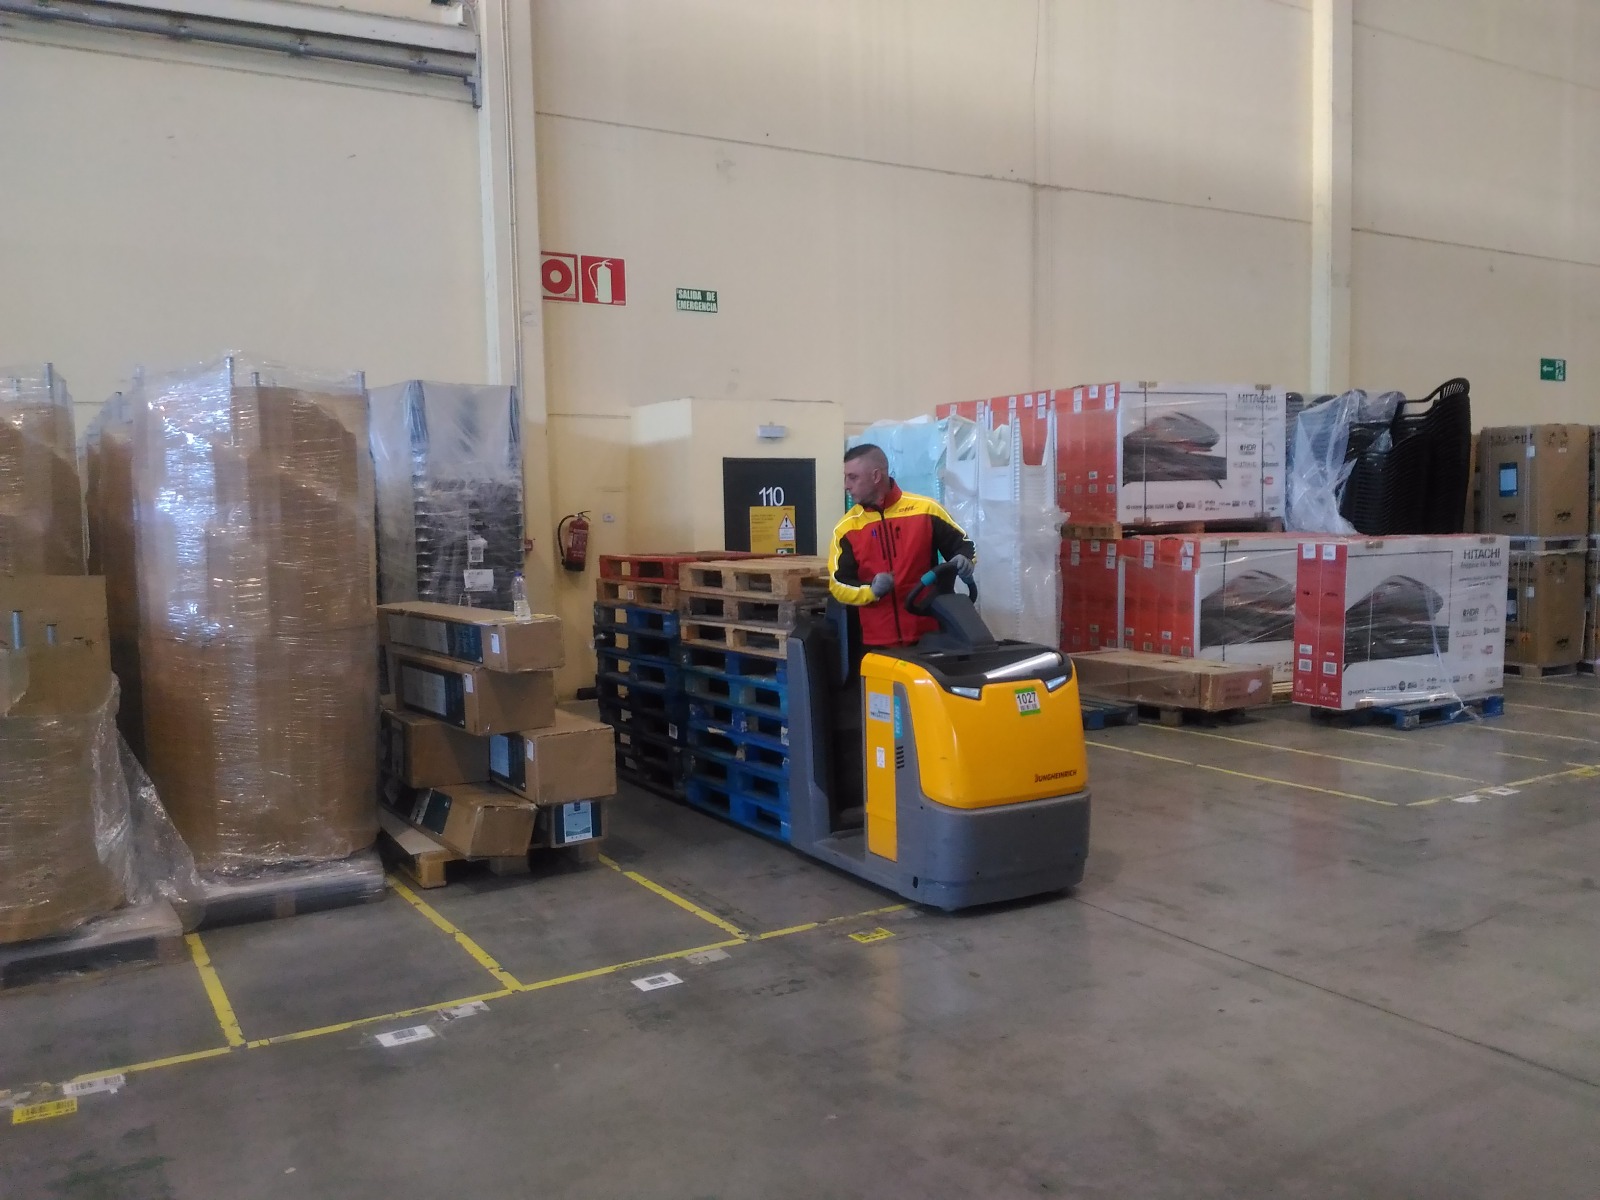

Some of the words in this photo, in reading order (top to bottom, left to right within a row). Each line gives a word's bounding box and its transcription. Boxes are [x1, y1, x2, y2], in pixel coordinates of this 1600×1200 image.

[678, 289, 702, 300] SALIDA
[706, 291, 716, 302] DE
[677, 300, 717, 312] EMERGENCIA
[1238, 393, 1276, 403] HITACHI
[758, 486, 785, 507] 110
[1463, 548, 1501, 560] HITACHI
[1016, 691, 1036, 705] 1027
[1034, 769, 1078, 783] JUNGHEINRICH
